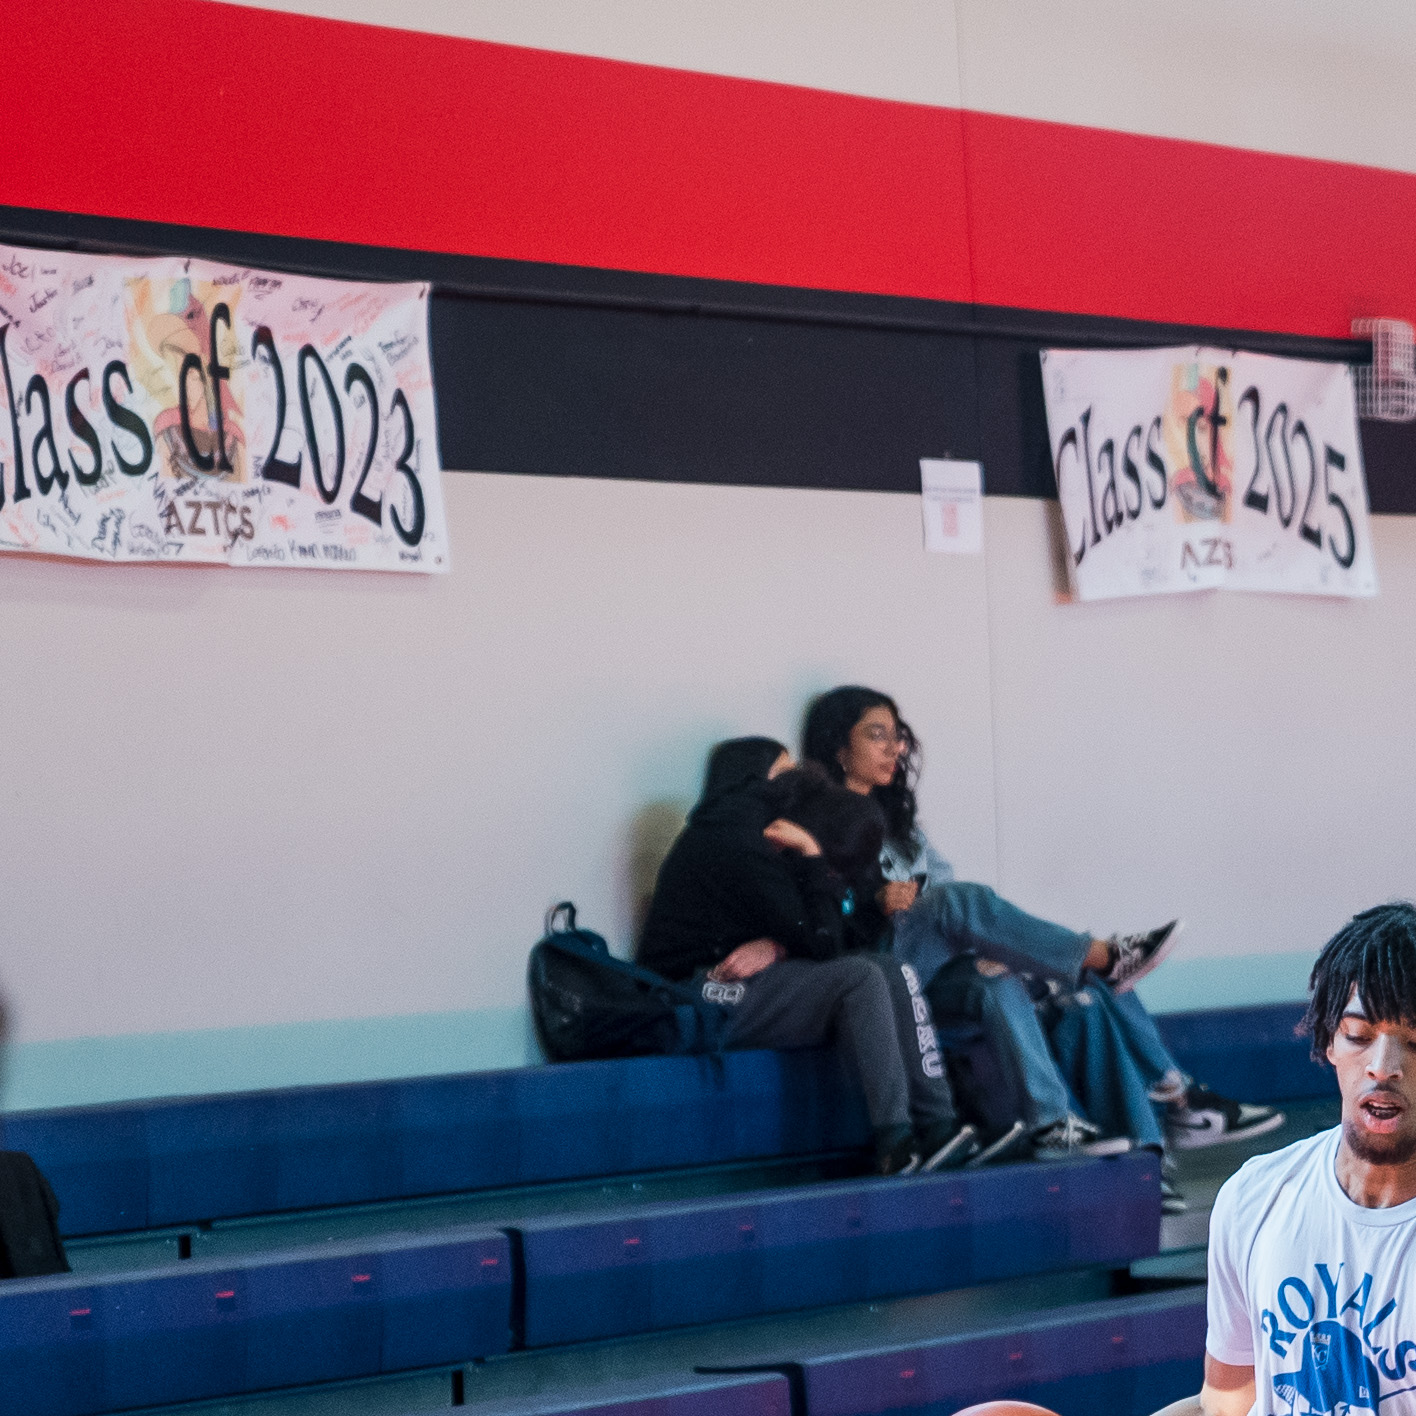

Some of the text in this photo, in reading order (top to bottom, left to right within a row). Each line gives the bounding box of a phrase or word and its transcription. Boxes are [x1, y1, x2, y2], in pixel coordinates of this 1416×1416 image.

[0, 302, 426, 547] lass of 2023
[1056, 366, 1357, 569] Class of 2025
